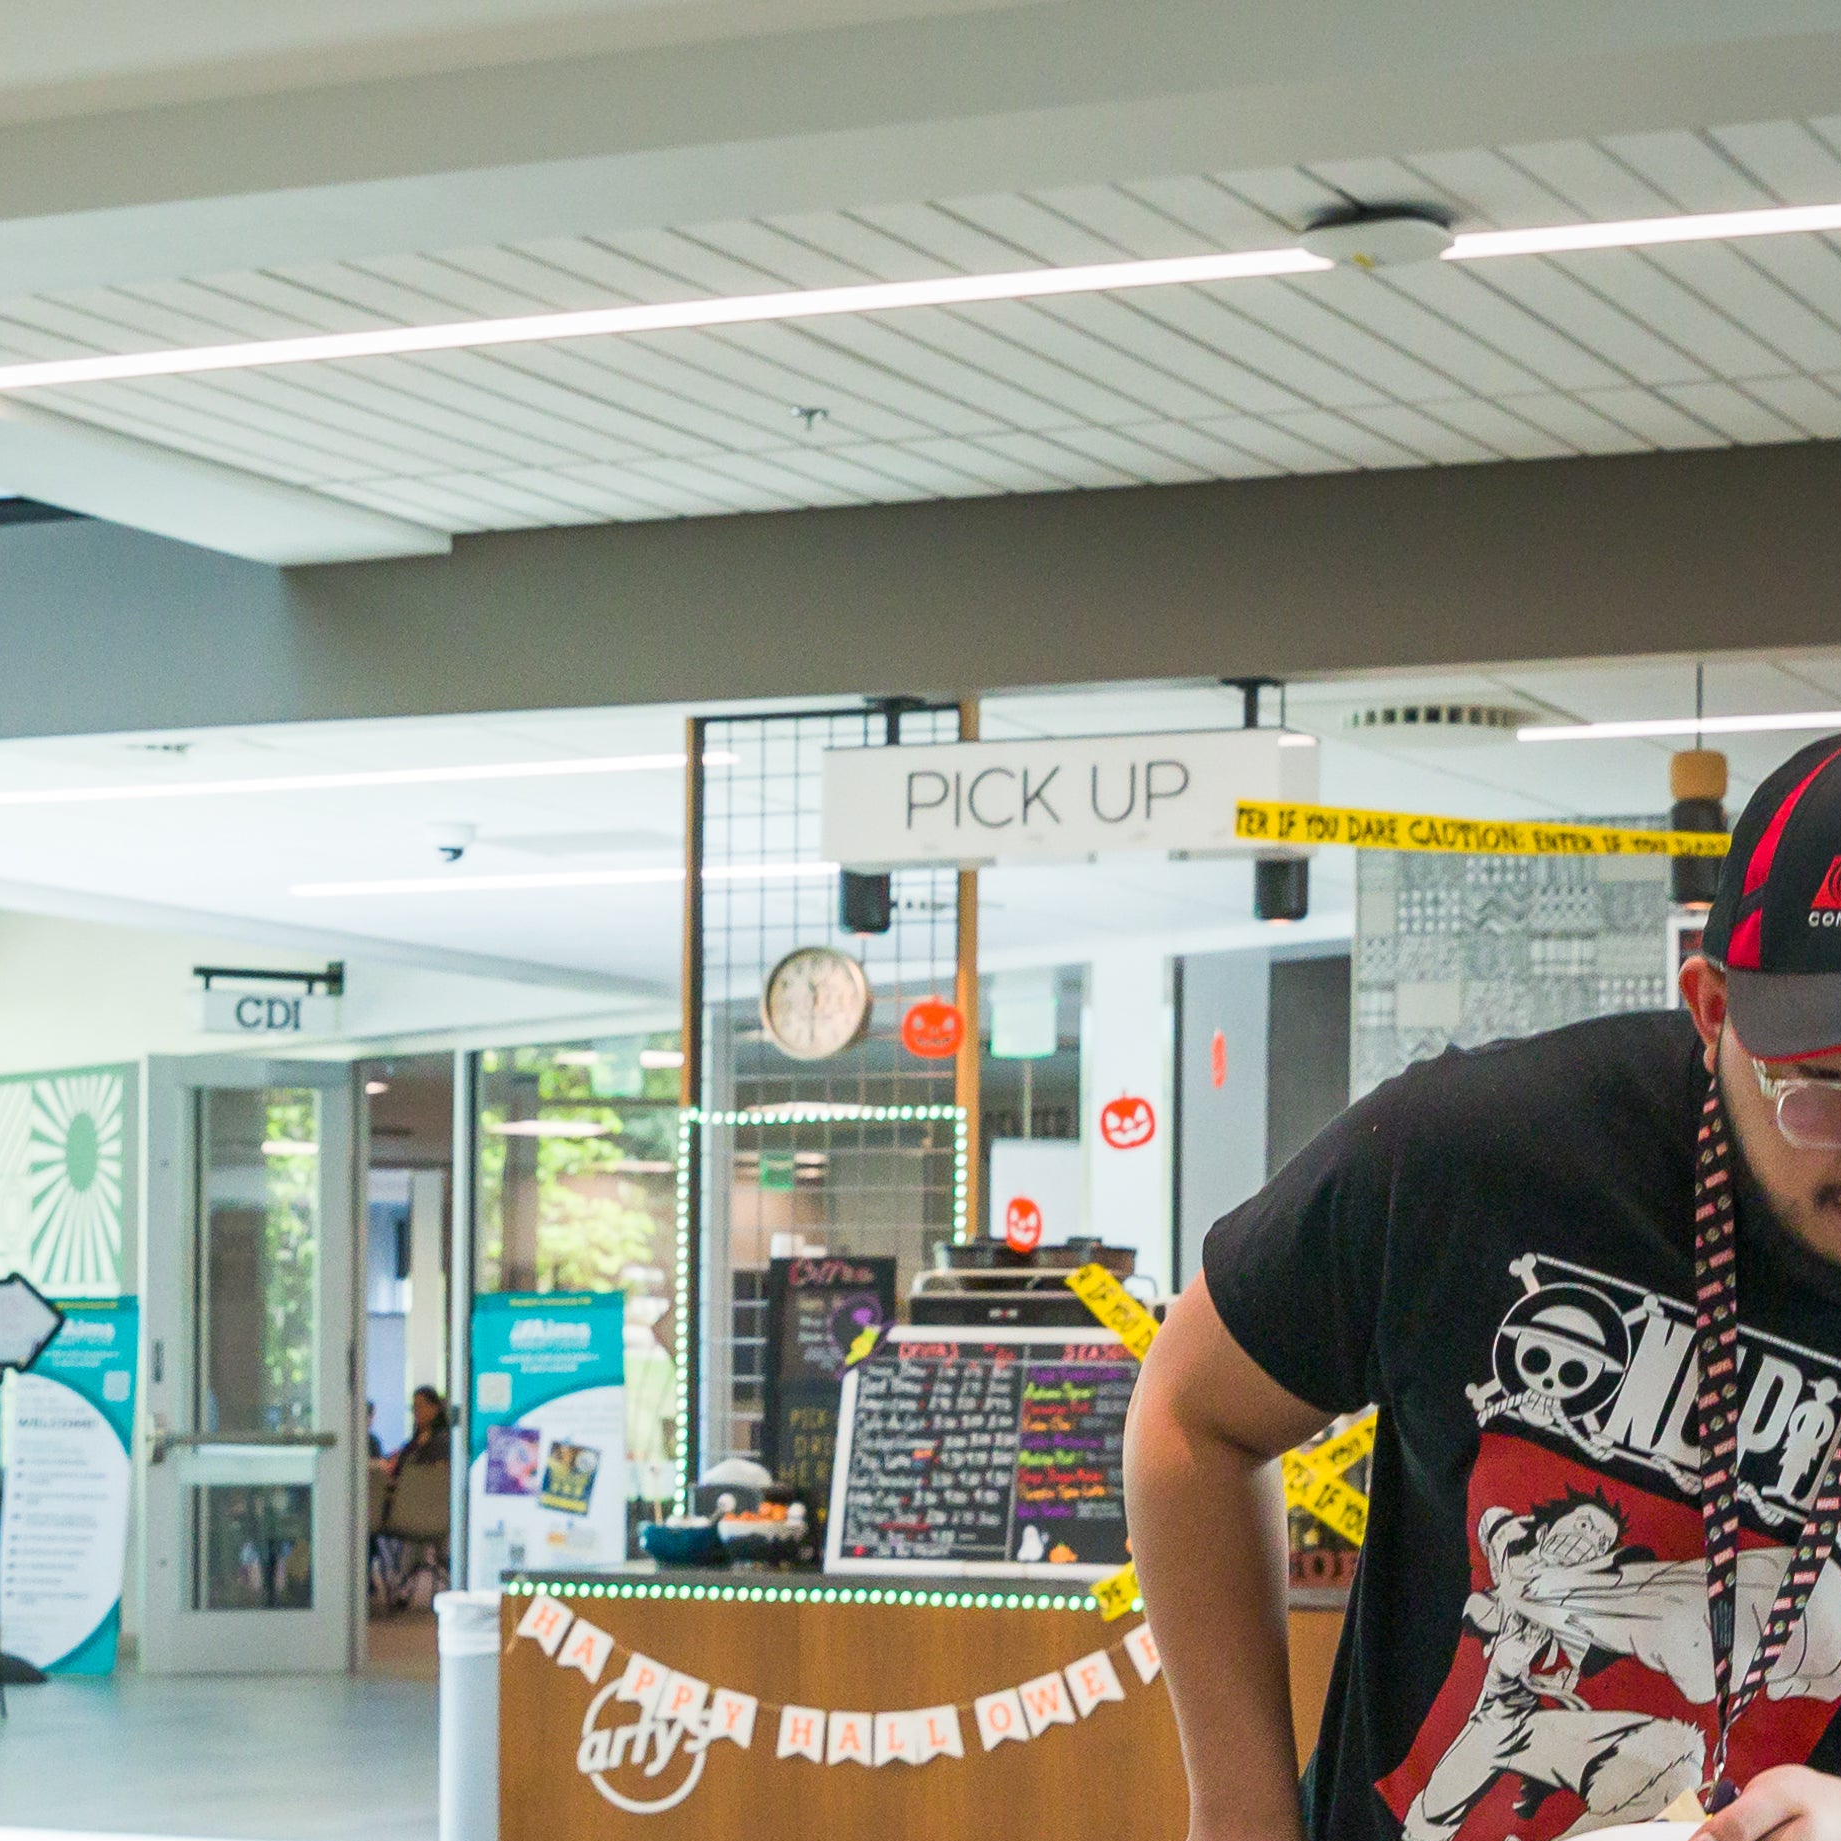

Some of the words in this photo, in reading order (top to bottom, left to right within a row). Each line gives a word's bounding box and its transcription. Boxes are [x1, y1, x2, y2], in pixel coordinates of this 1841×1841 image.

[906, 765, 1061, 831] PICK
[1091, 760, 1190, 824] UP
[1277, 810, 1297, 839] IF
[1304, 813, 1338, 842] YOU
[1346, 815, 1397, 846] DARE
[1408, 818, 1525, 852] CAUTION:
[1533, 829, 1595, 852] ENTER
[235, 997, 301, 1030] CDI
[532, 1604, 744, 1732] HAPPY
